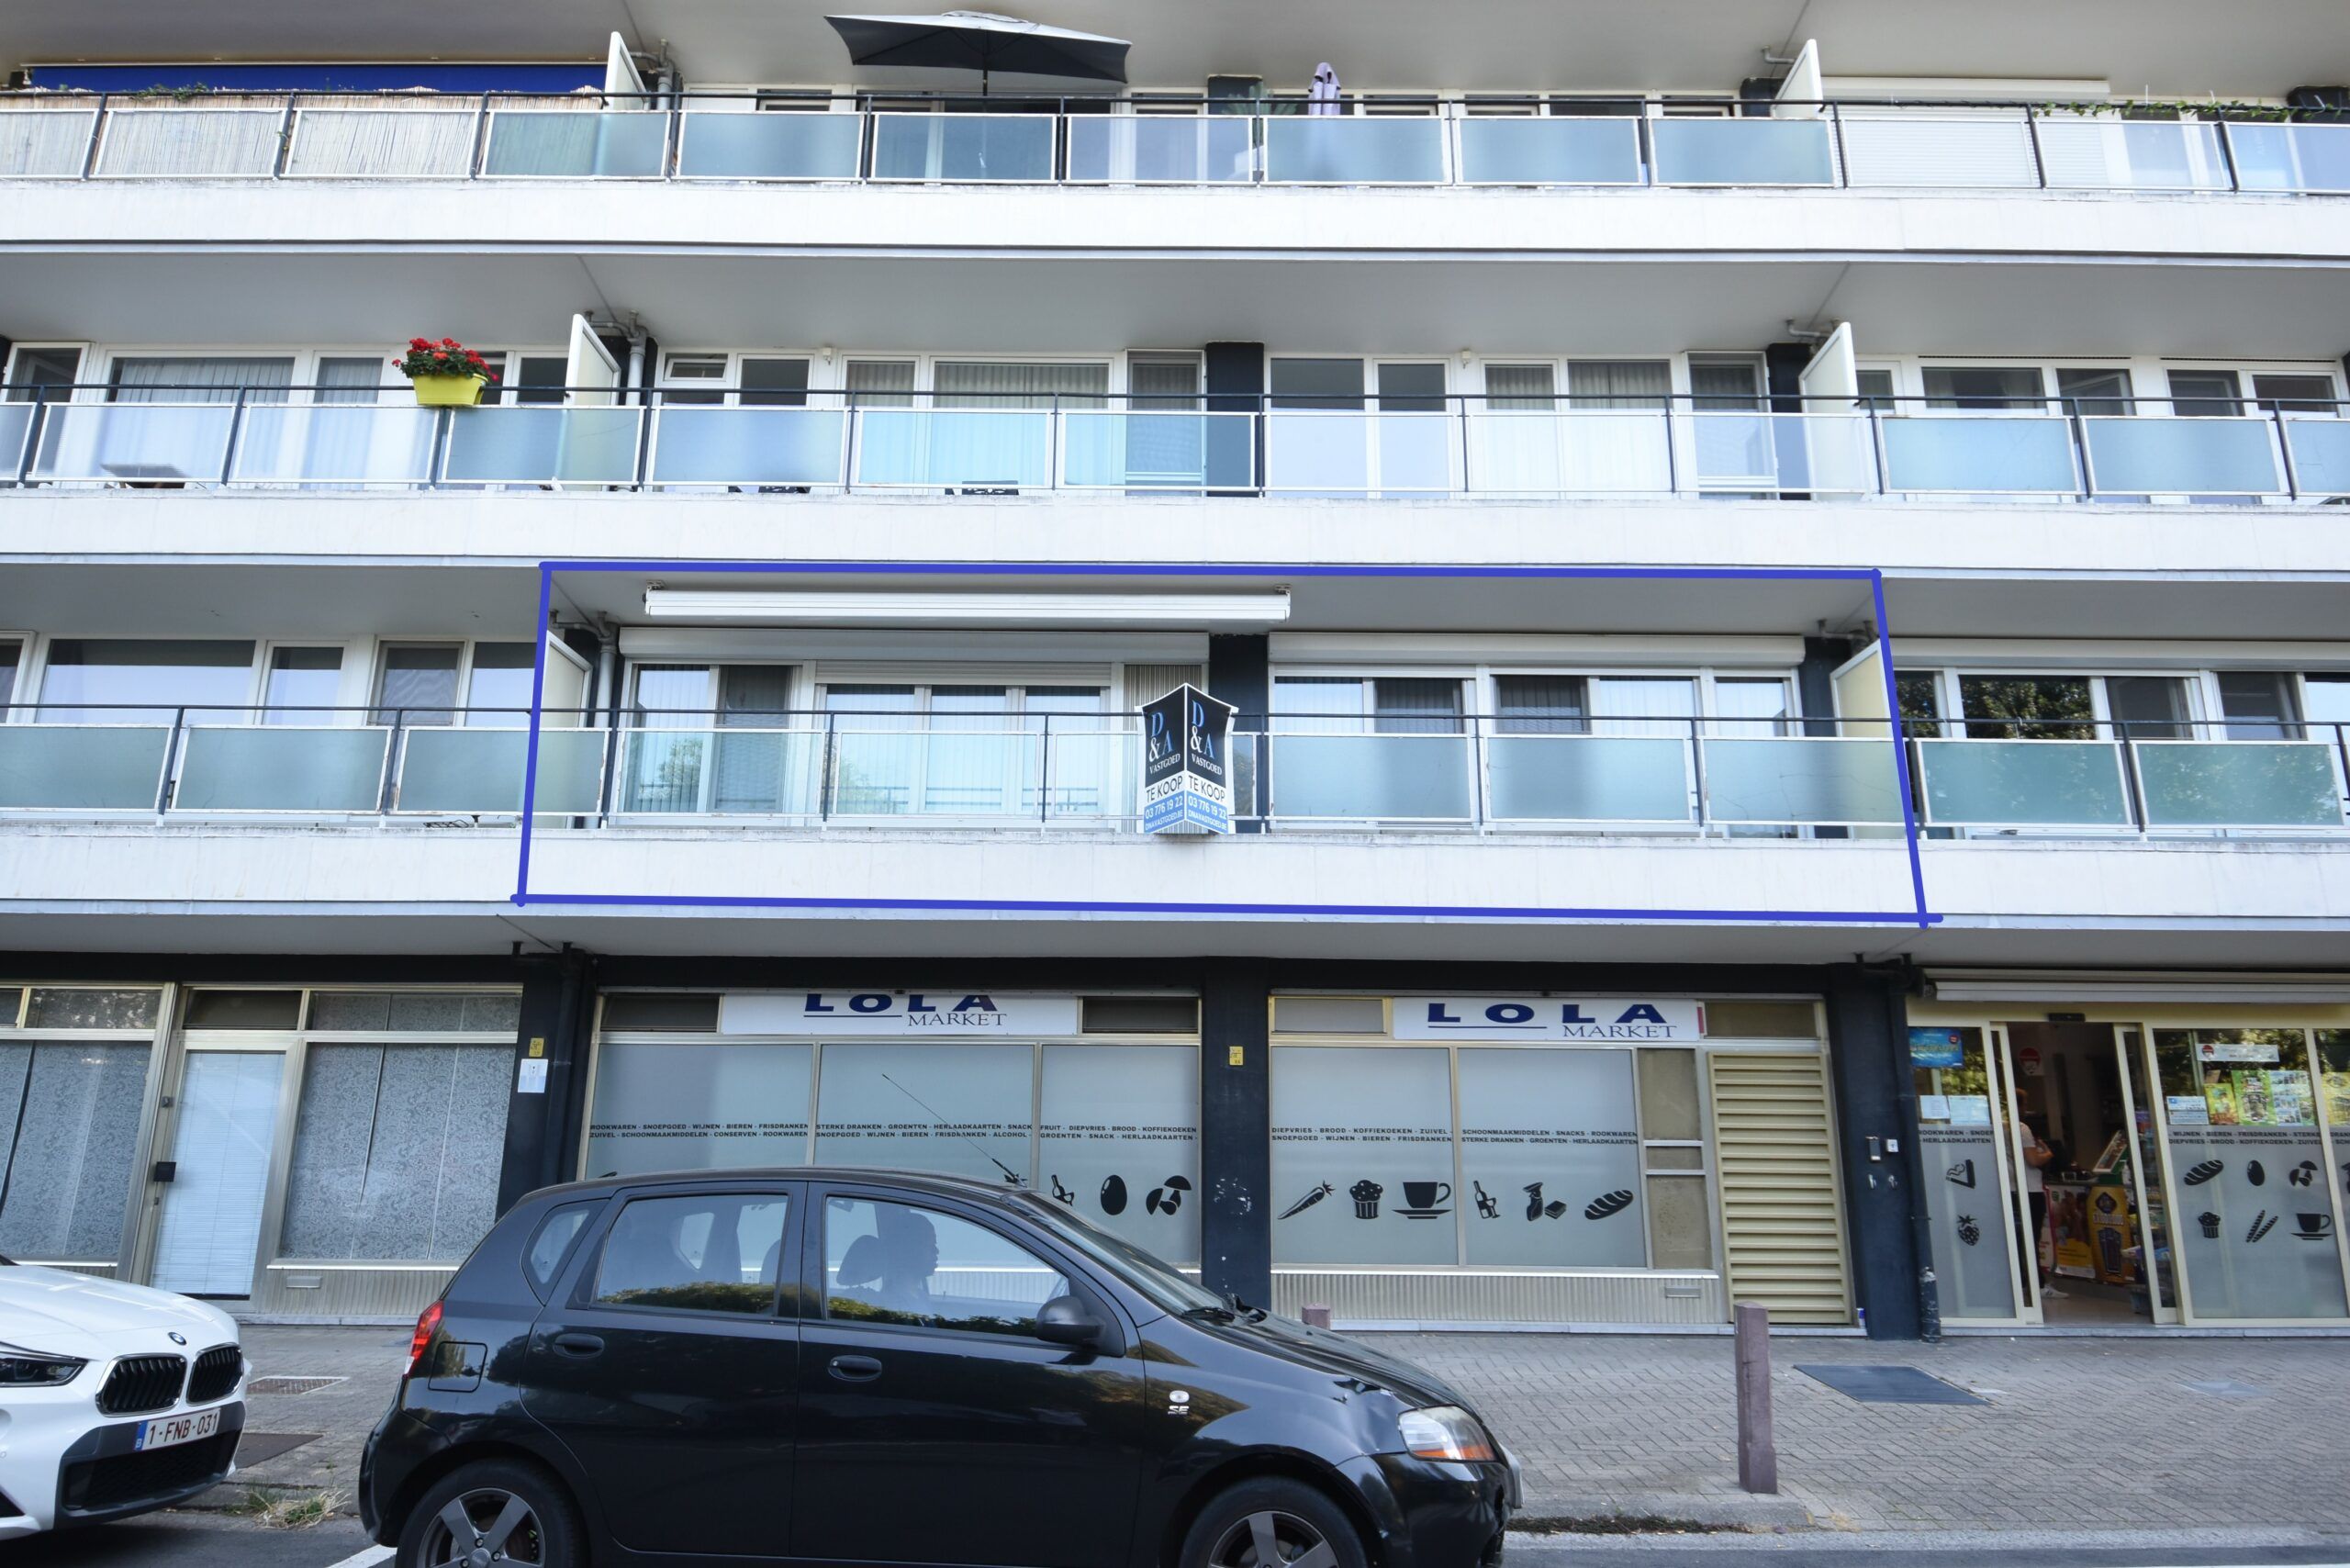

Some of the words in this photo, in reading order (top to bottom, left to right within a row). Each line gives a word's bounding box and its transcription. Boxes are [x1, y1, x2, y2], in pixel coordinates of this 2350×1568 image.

[1149, 753, 1181, 775] VASTGOED
[1191, 754, 1222, 776] VASTGOED
[1146, 788, 1156, 803] TE
[1158, 775, 1183, 798] KOOP
[1189, 775, 1198, 792] TE
[1202, 780, 1225, 801] KOOP
[1145, 808, 1154, 820] 03
[1155, 803, 1166, 816] 776
[1167, 799, 1174, 810] 19
[1175, 795, 1183, 808] 22
[1188, 796, 1198, 808] 03
[1198, 800, 1211, 813] 776
[1211, 805, 1218, 816] 19
[1218, 808, 1226, 820] 22
[805, 993, 998, 1014] LOLA
[1427, 1002, 1667, 1024] LOLA
[907, 1013, 1008, 1026] MARKET
[1562, 1025, 1677, 1038] MARKET
[1167, 1405, 1190, 1415] SE
[150, 1414, 218, 1445] 1-FNB-031
